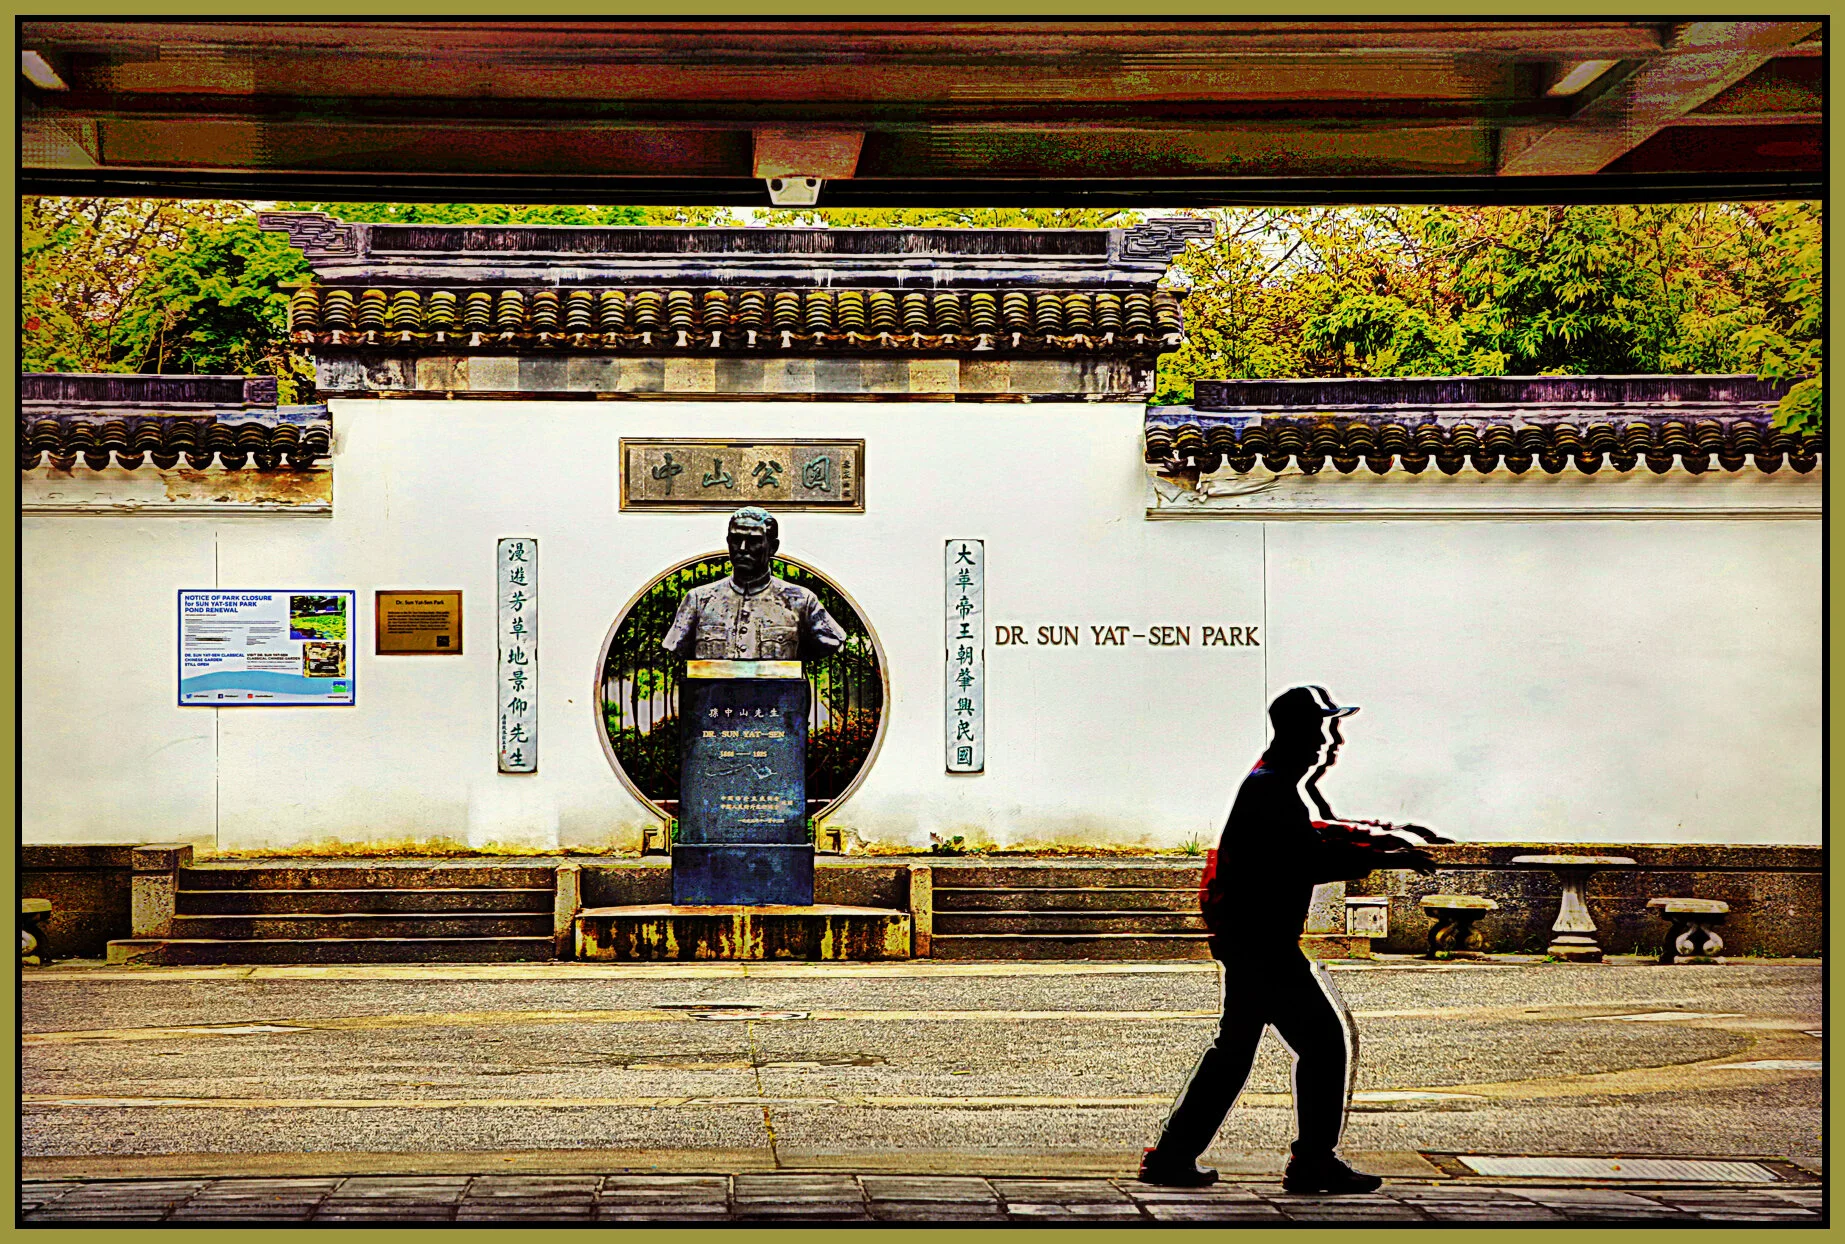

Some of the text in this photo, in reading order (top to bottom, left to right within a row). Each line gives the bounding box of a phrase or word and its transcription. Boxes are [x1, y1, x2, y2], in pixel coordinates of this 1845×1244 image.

[995, 626, 1260, 645] DR. SUN YAT-SEN PARK
[708, 708, 780, 718] 孫中山先生
